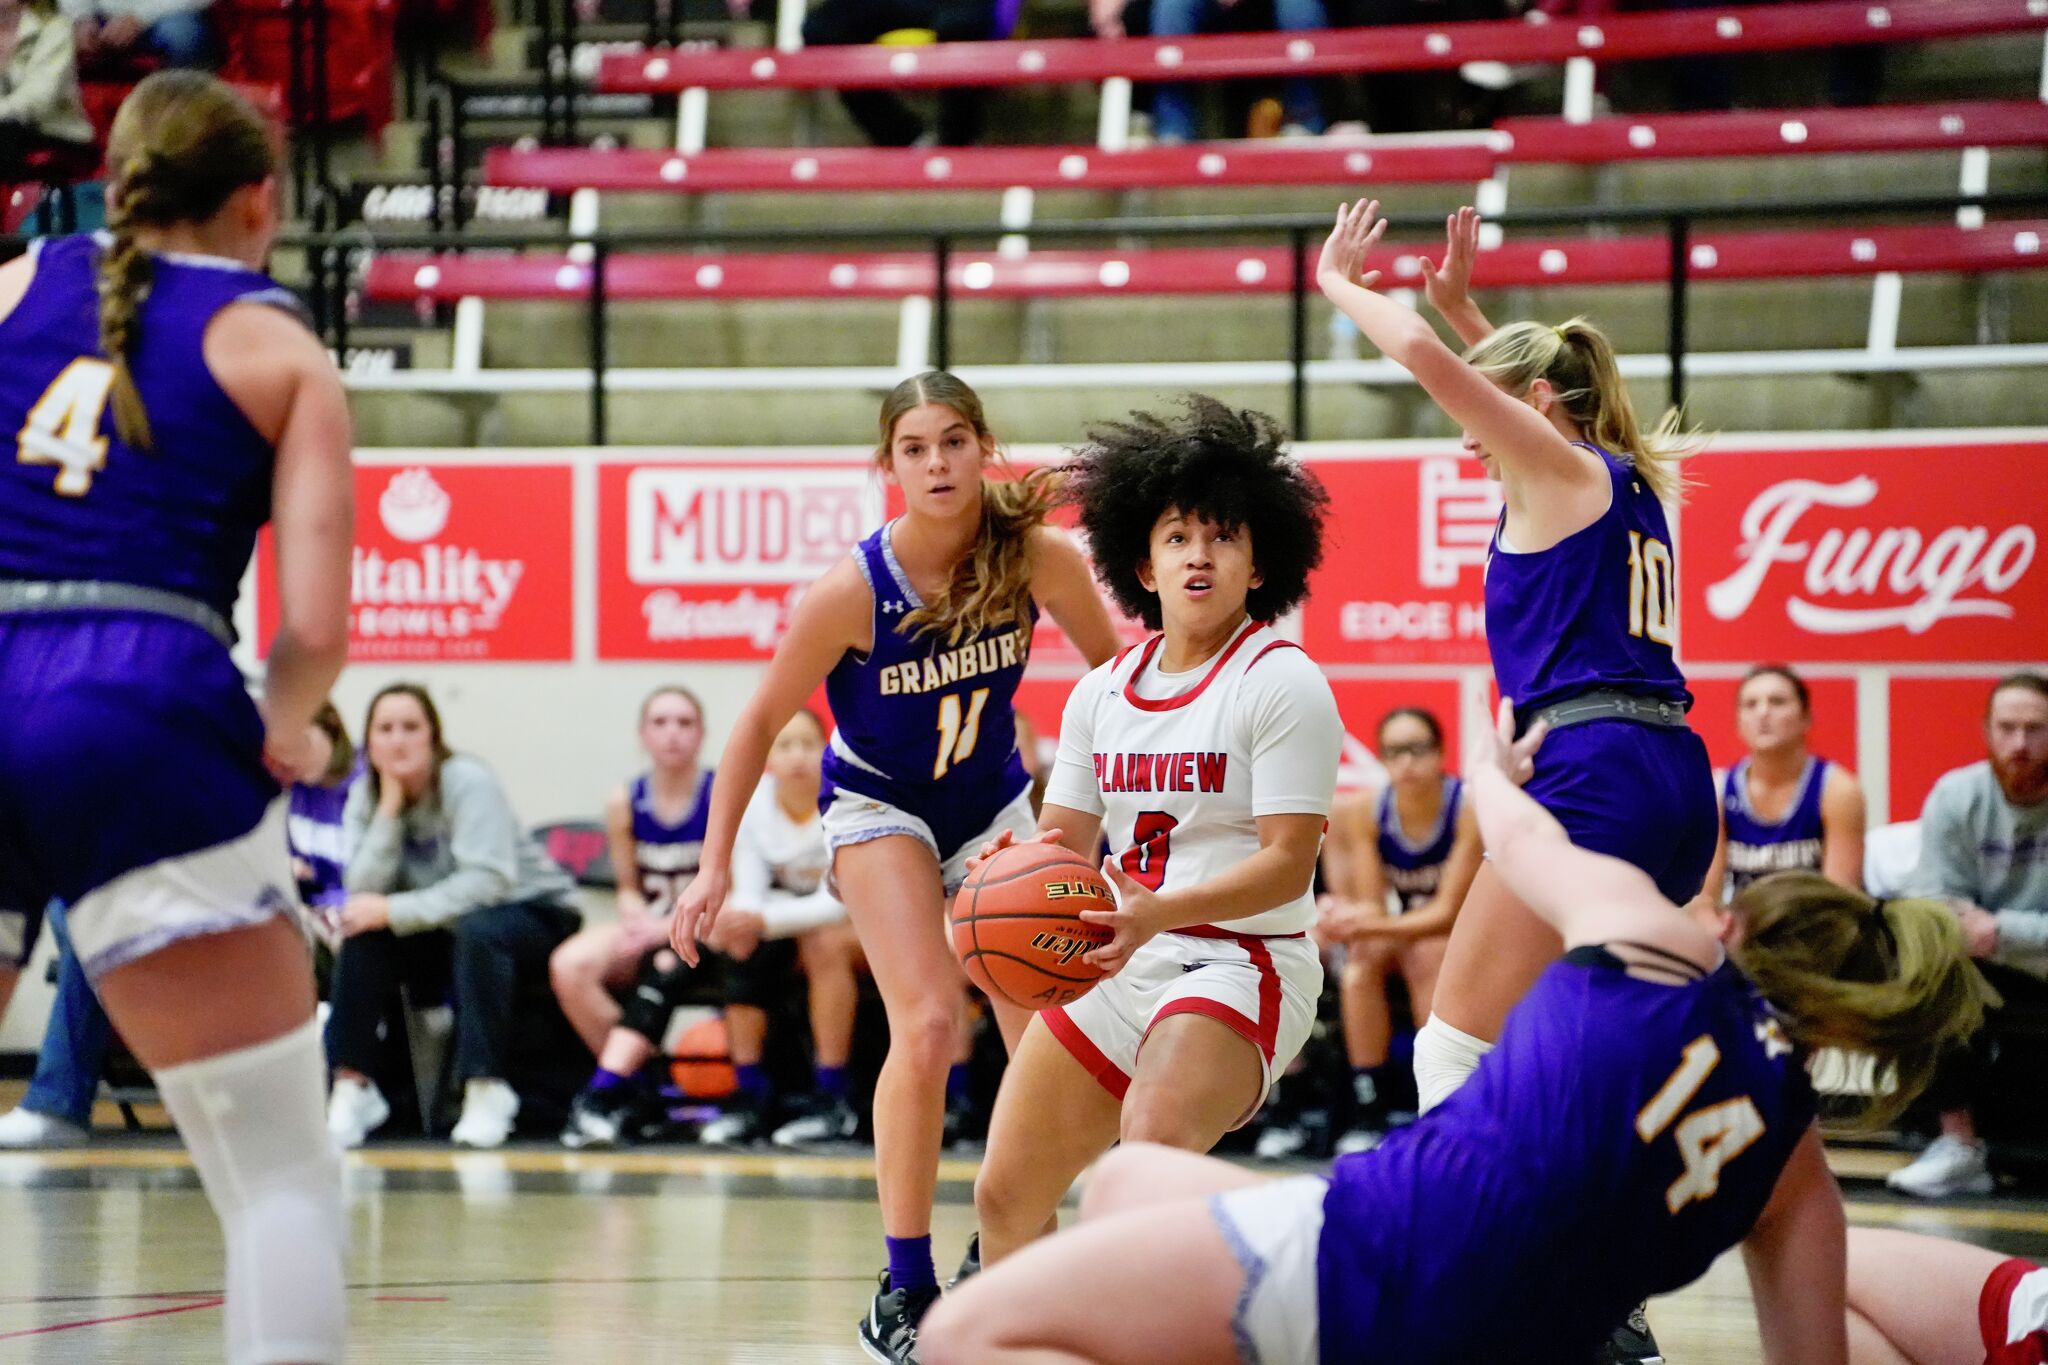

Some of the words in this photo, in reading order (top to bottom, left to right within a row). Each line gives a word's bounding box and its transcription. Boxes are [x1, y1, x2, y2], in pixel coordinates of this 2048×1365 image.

[16, 355, 118, 497] 4
[351, 543, 526, 630] itality
[1628, 530, 1675, 648] 10
[1705, 473, 2037, 635] Fungo
[1339, 601, 1452, 641] EDGE
[933, 687, 990, 781] 11
[1093, 751, 1228, 793] PLAINVIEW
[1120, 811, 1179, 893] 0
[1031, 932, 1105, 966] den
[1634, 1033, 1767, 1216] 14
